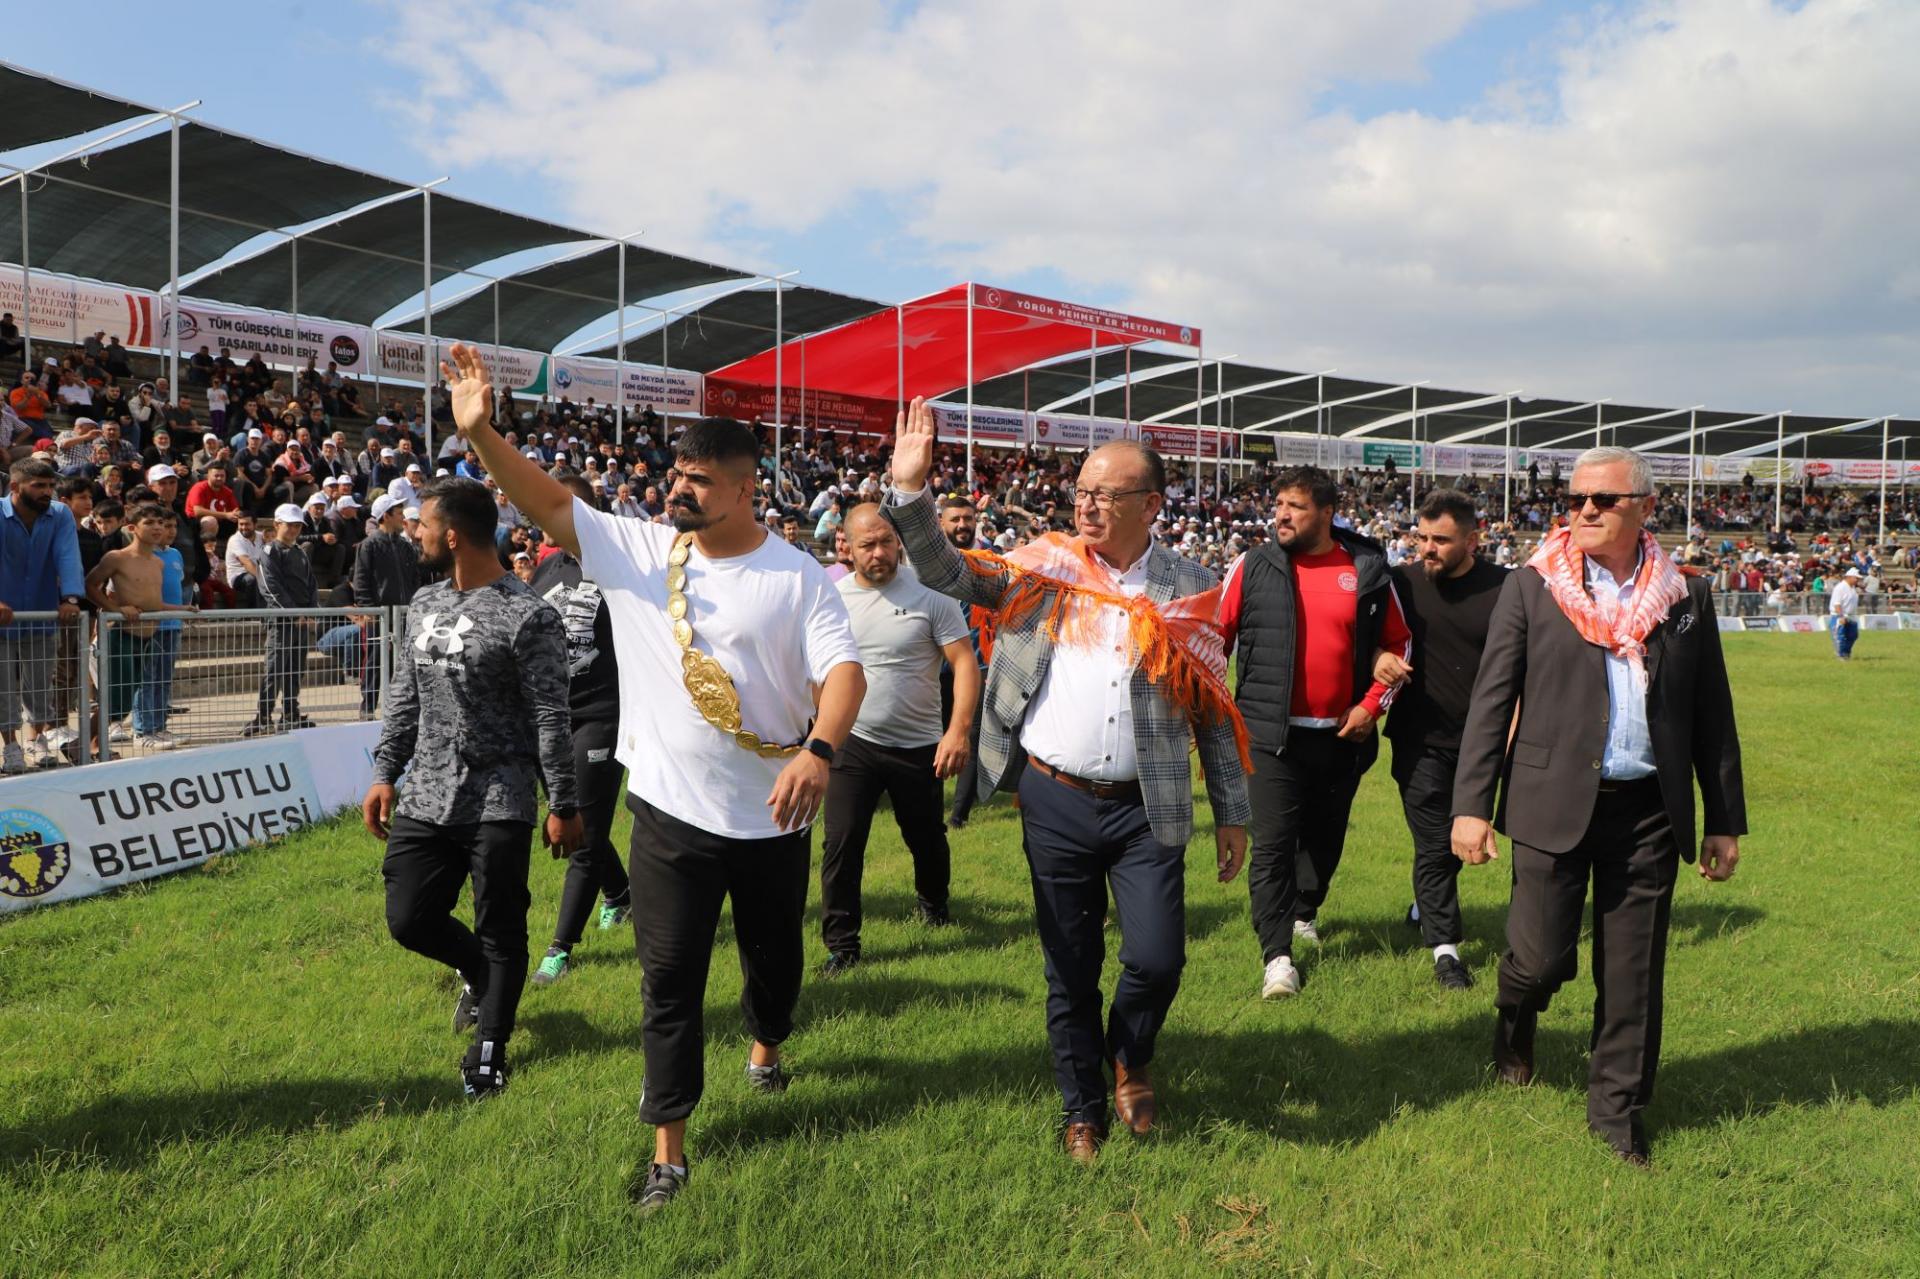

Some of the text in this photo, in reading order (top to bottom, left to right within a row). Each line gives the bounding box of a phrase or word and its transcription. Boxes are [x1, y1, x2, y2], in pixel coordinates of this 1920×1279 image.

[208, 316, 232, 331] TÜM
[1017, 300, 1054, 316] YÖRÜK
[1058, 309, 1101, 324] MEHMET
[1105, 318, 1118, 328] ER
[1121, 321, 1167, 336] MEYDANI
[218, 337, 278, 355] BAŞARILAR
[622, 382, 636, 390] TÜM
[821, 400, 832, 411] ER
[832, 402, 865, 415] MEYDANI
[947, 412, 963, 421] TÜM
[79, 762, 292, 826] TURGUTLU
[89, 797, 313, 879] BELEDİYESİ
